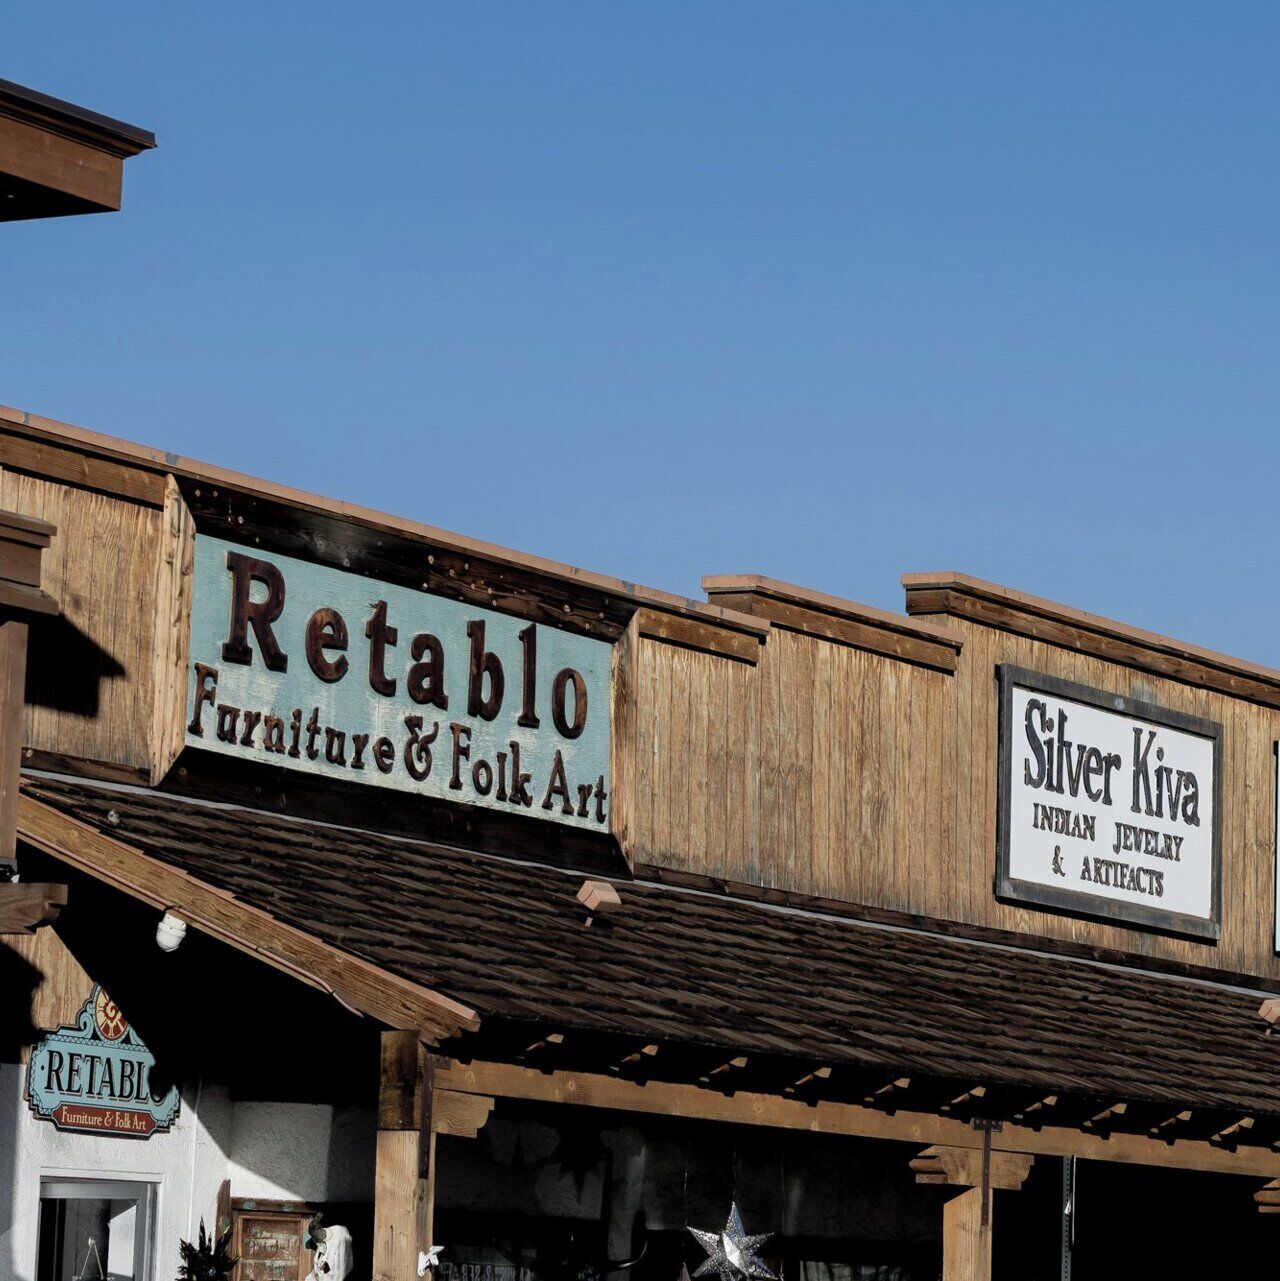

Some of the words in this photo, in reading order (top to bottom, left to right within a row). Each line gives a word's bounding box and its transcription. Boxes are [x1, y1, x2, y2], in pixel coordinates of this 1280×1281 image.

[221, 551, 588, 740] Retablo
[187, 662, 396, 774] Furniture
[404, 715, 439, 781] &
[449, 722, 534, 808] Folk
[541, 749, 607, 823] Art
[1024, 697, 1121, 806] Silver
[1131, 726, 1201, 827] Kiva
[1032, 803, 1096, 842] INDIAN
[1113, 822, 1185, 862] JEWELRY
[1052, 845, 1065, 877] &
[1080, 856, 1164, 898] ARTIFACTS
[61, 1106, 102, 1126] Furniture
[104, 1112, 114, 1126] &
[115, 1111, 131, 1129] Folk
[132, 1114, 146, 1131] Art
